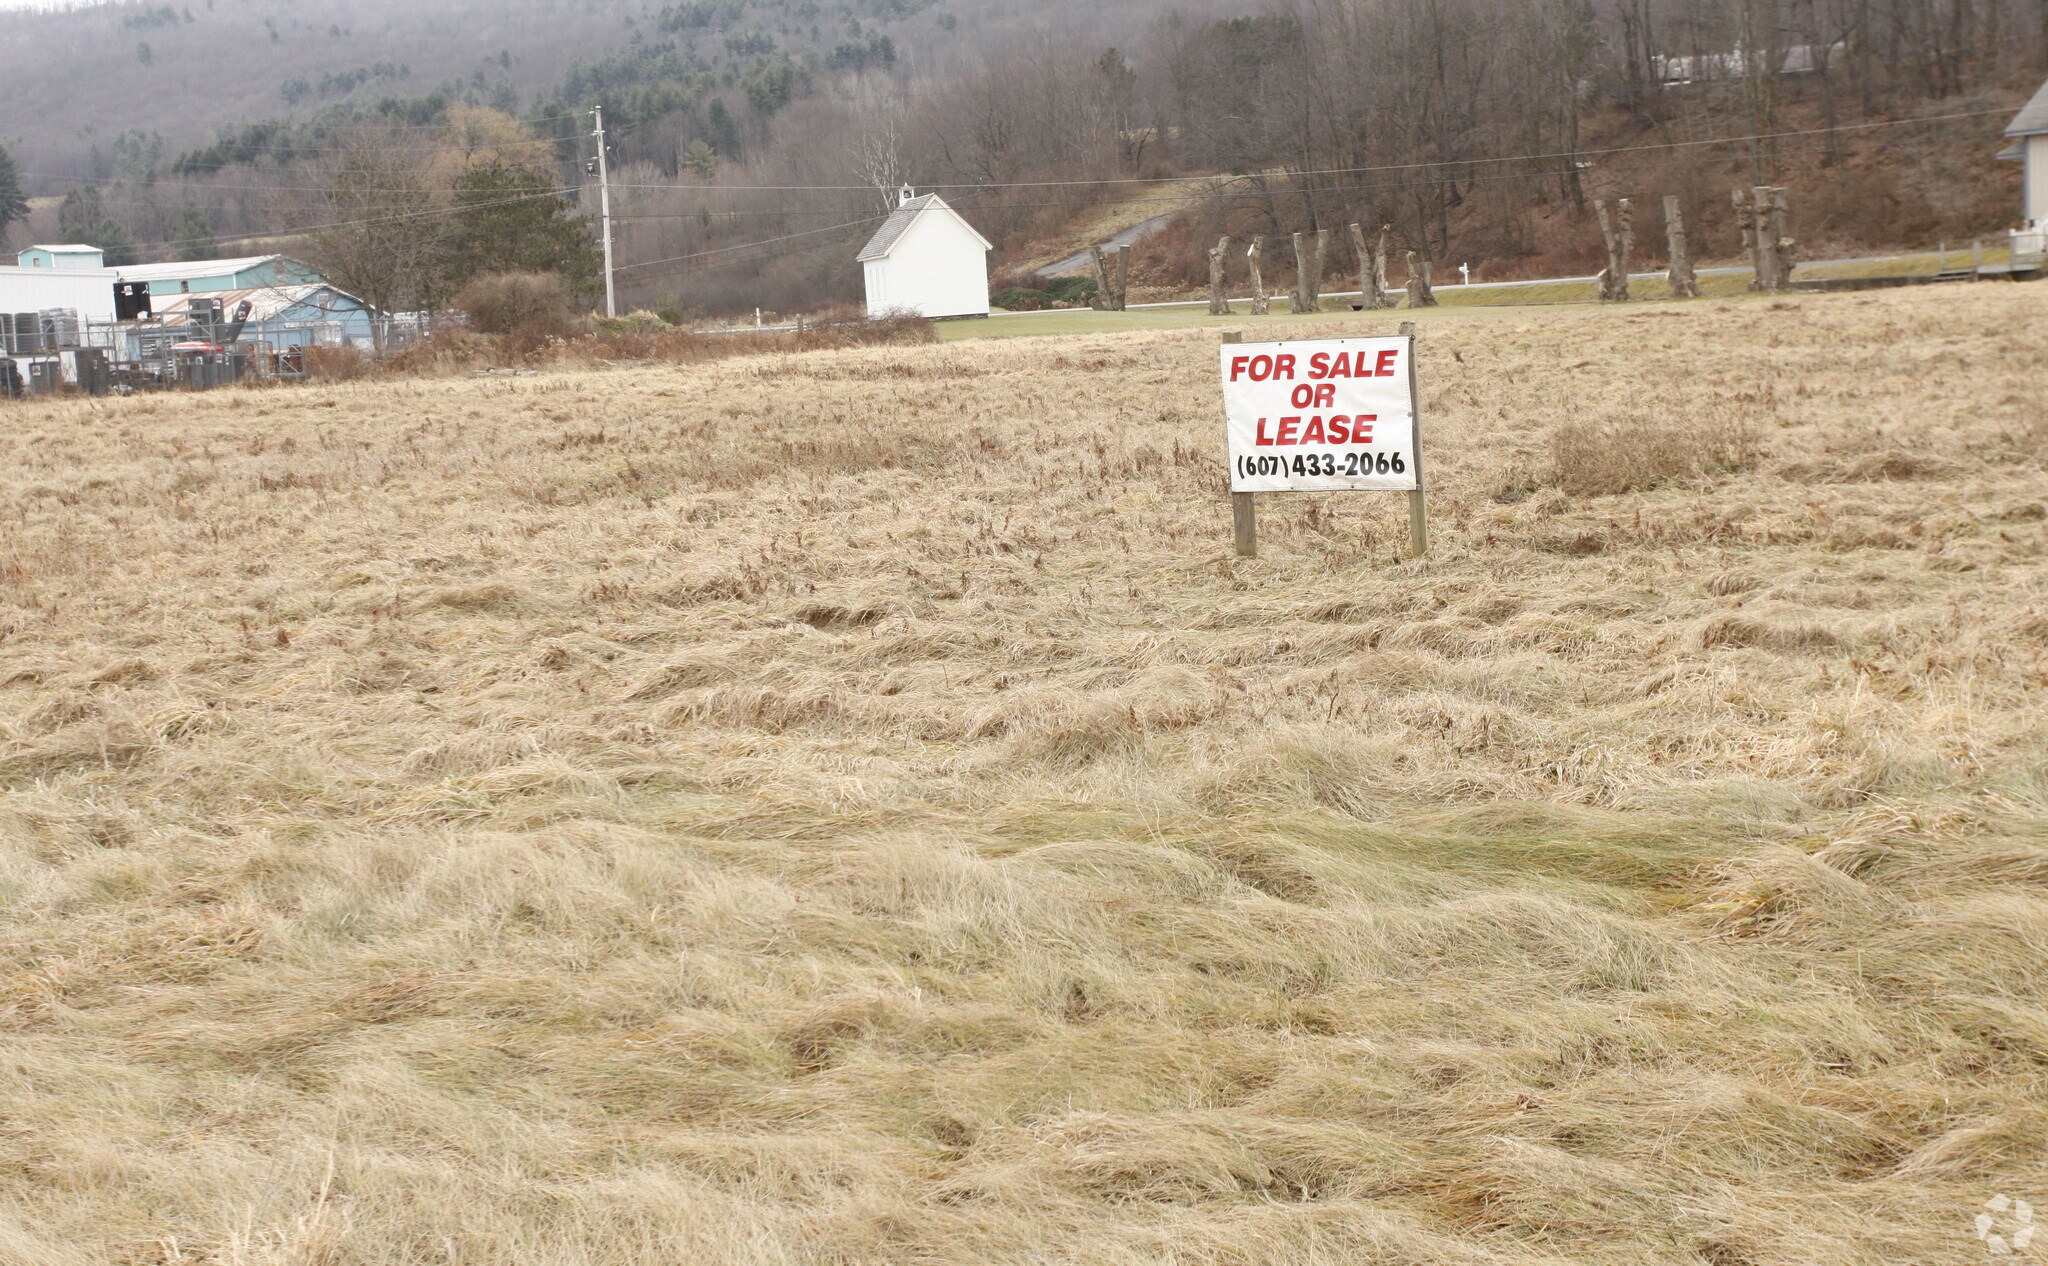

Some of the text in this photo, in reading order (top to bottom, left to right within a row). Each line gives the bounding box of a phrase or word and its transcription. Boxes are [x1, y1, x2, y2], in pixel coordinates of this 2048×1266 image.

[1230, 350, 1398, 382] FOR SALE
[1291, 383, 1336, 409] OR
[1255, 414, 1377, 446] LEASE
[1237, 452, 1405, 480] (607)433-2066
